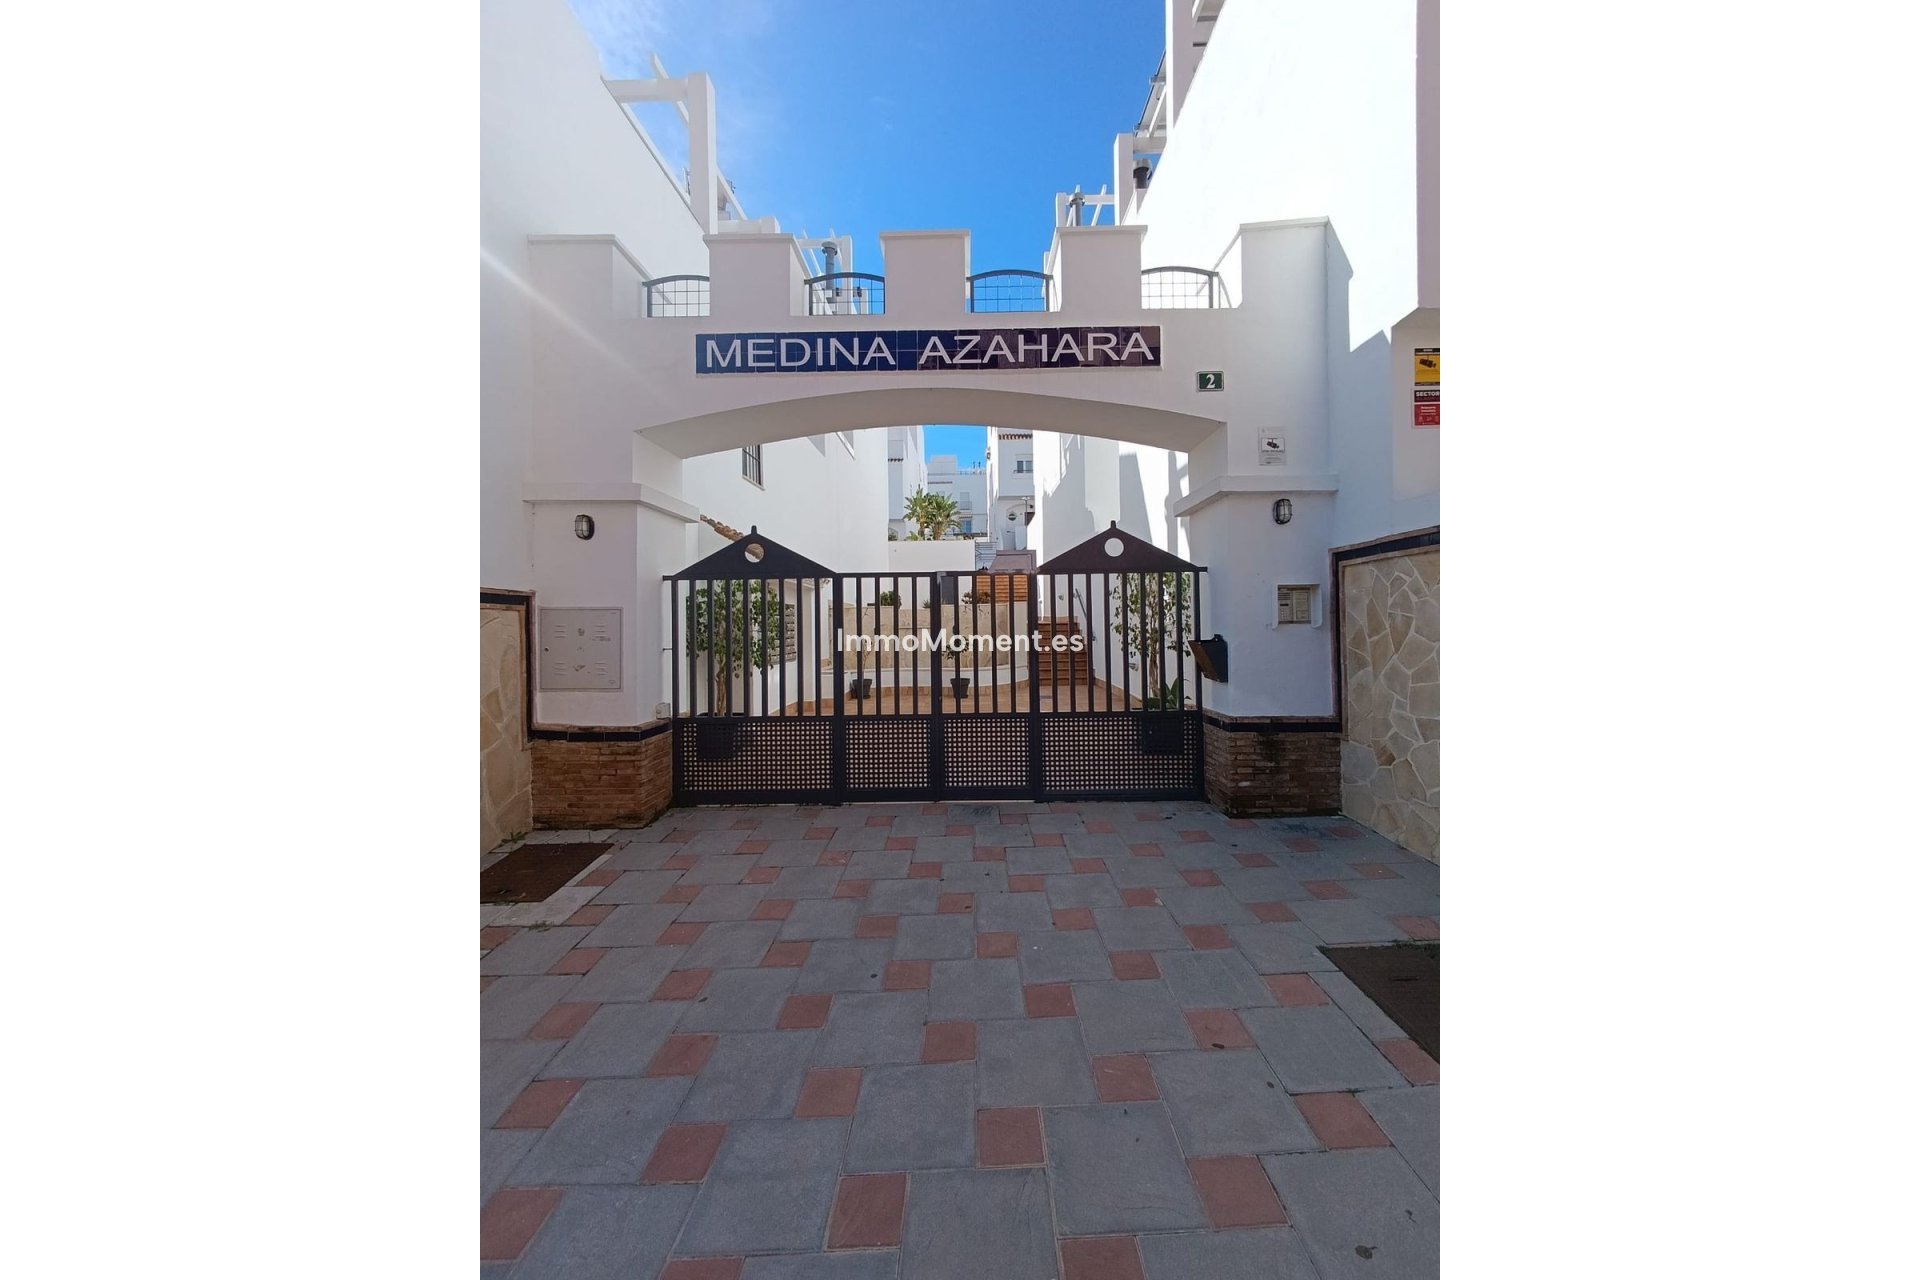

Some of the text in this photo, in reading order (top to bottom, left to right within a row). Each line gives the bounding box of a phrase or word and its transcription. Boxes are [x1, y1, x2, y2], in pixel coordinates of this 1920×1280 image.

[706, 332, 1154, 367] MEDINA AZAHARA
[1206, 373, 1216, 389] 2
